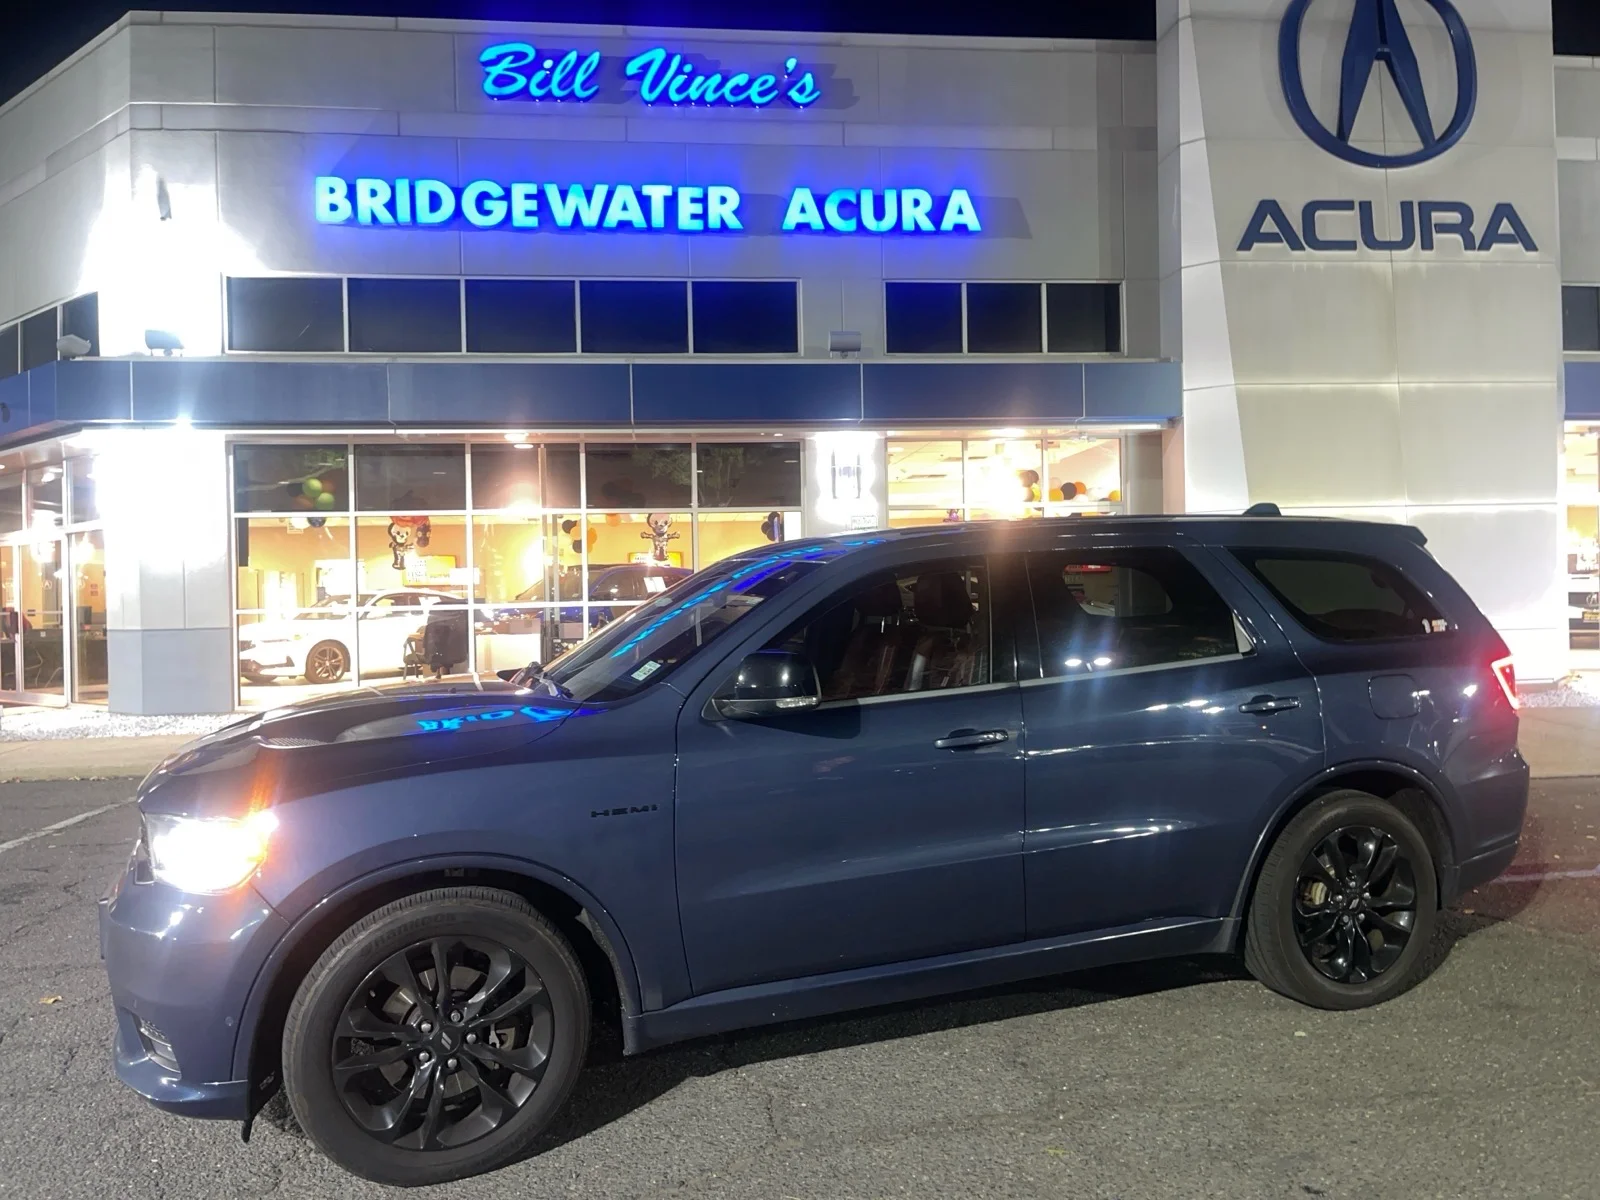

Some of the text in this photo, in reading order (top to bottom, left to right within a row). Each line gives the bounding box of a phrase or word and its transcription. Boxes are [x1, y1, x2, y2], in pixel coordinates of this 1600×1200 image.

[479, 42, 821, 106] Bill Vince's
[315, 176, 982, 233] BRIDGEWATER ACURA
[1236, 198, 1539, 253] ACURA
[590, 803, 659, 819] HEMI
